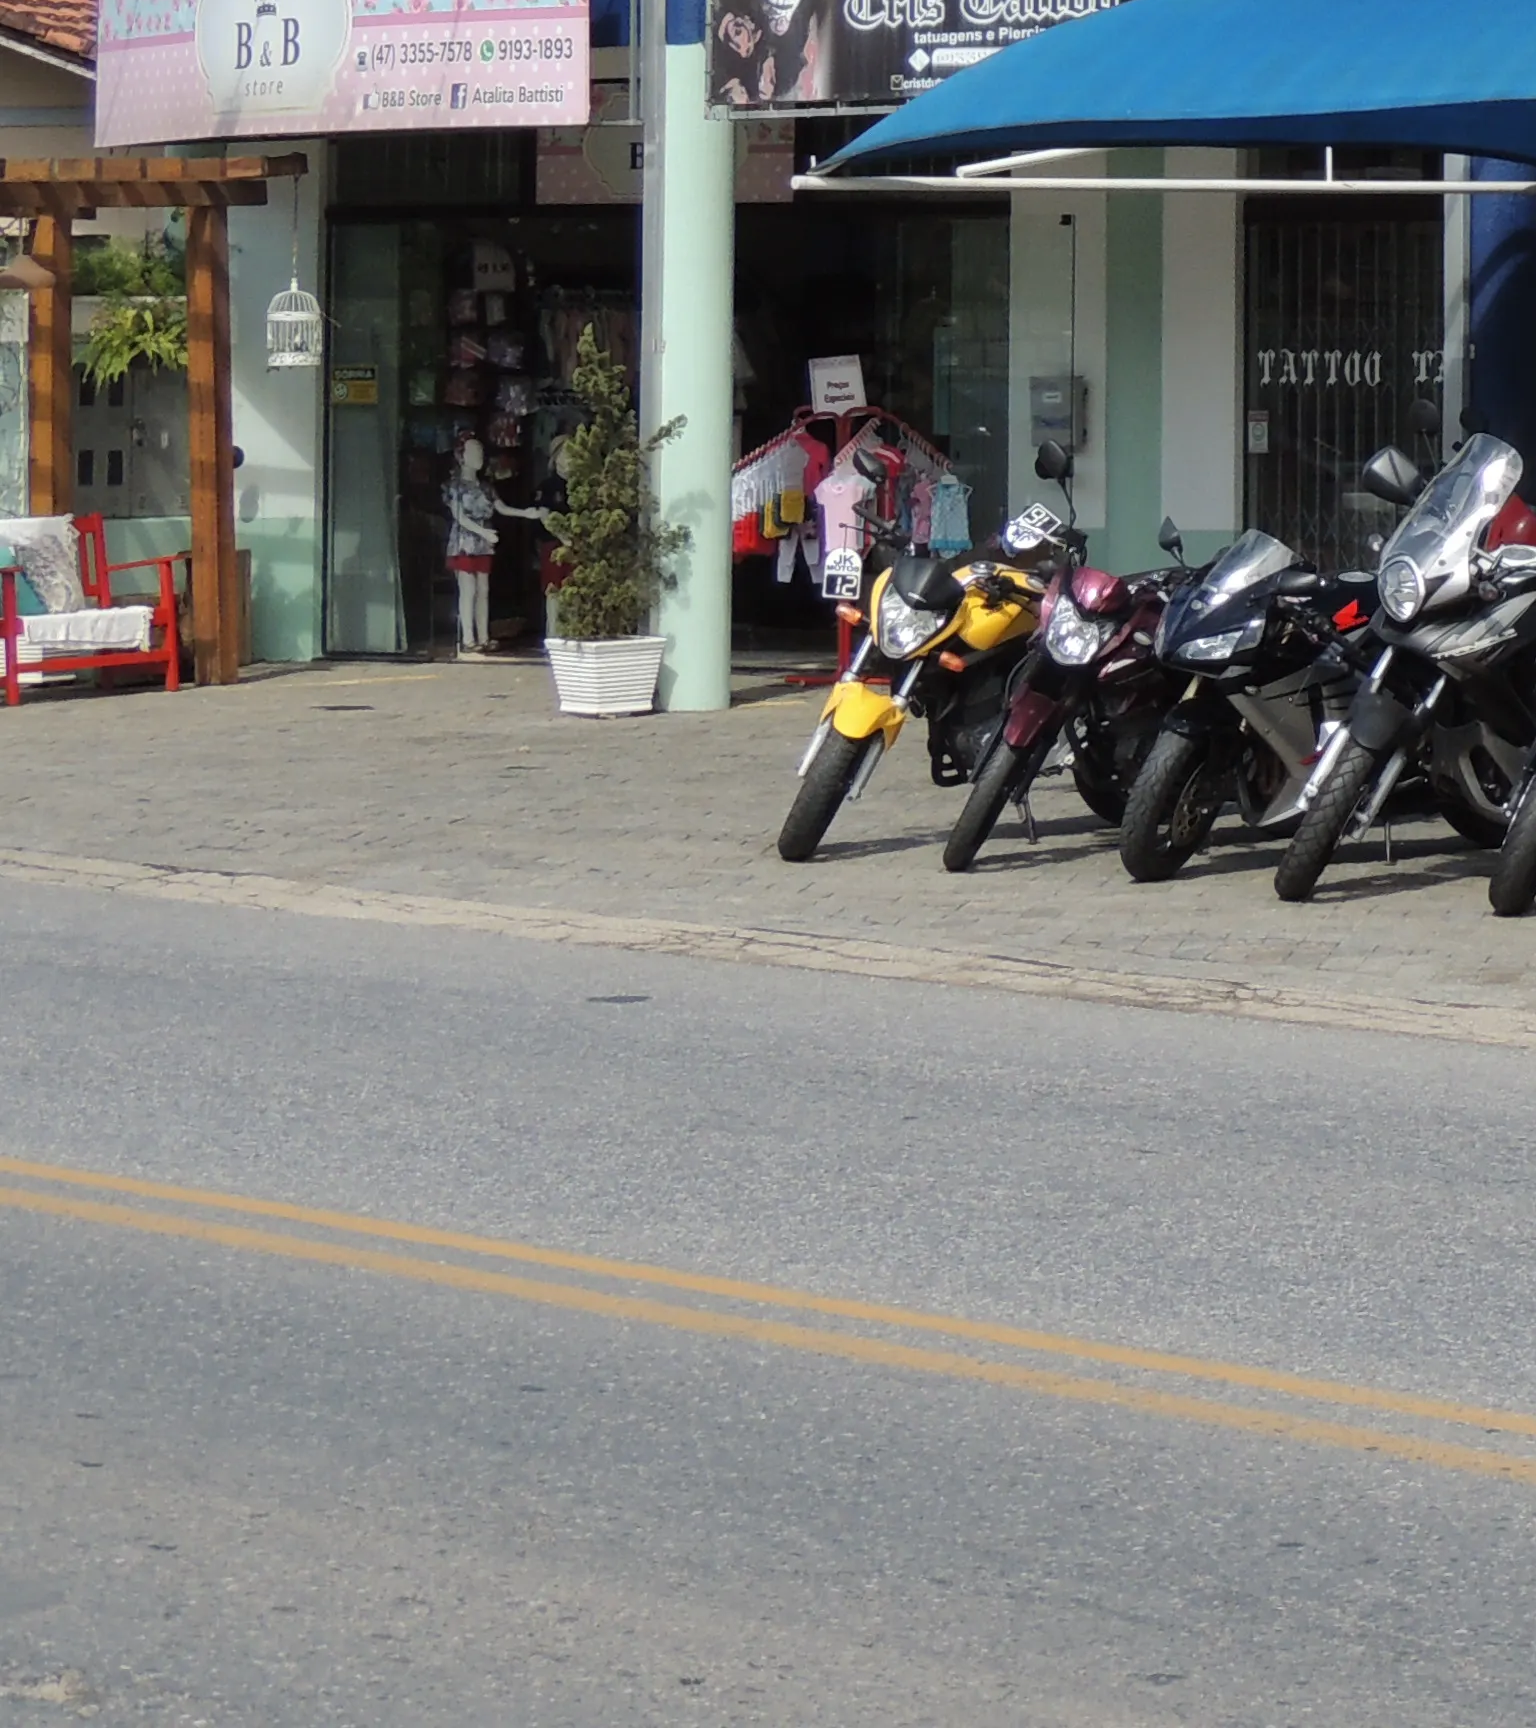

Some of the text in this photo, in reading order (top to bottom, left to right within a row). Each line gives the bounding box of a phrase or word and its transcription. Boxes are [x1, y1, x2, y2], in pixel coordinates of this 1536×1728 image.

[234, 17, 301, 70] B & B
[914, 31, 983, 46] tatuagens
[986, 29, 995, 41] e
[371, 37, 574, 71] (47) 3355-7578 9193-1893
[245, 78, 284, 97] store
[408, 88, 442, 107] Store
[472, 86, 515, 105] Atalita
[518, 83, 564, 104] Battisti
[1257, 348, 1382, 387] TATTOO
[833, 554, 855, 566] JK
[836, 575, 858, 596] 12
